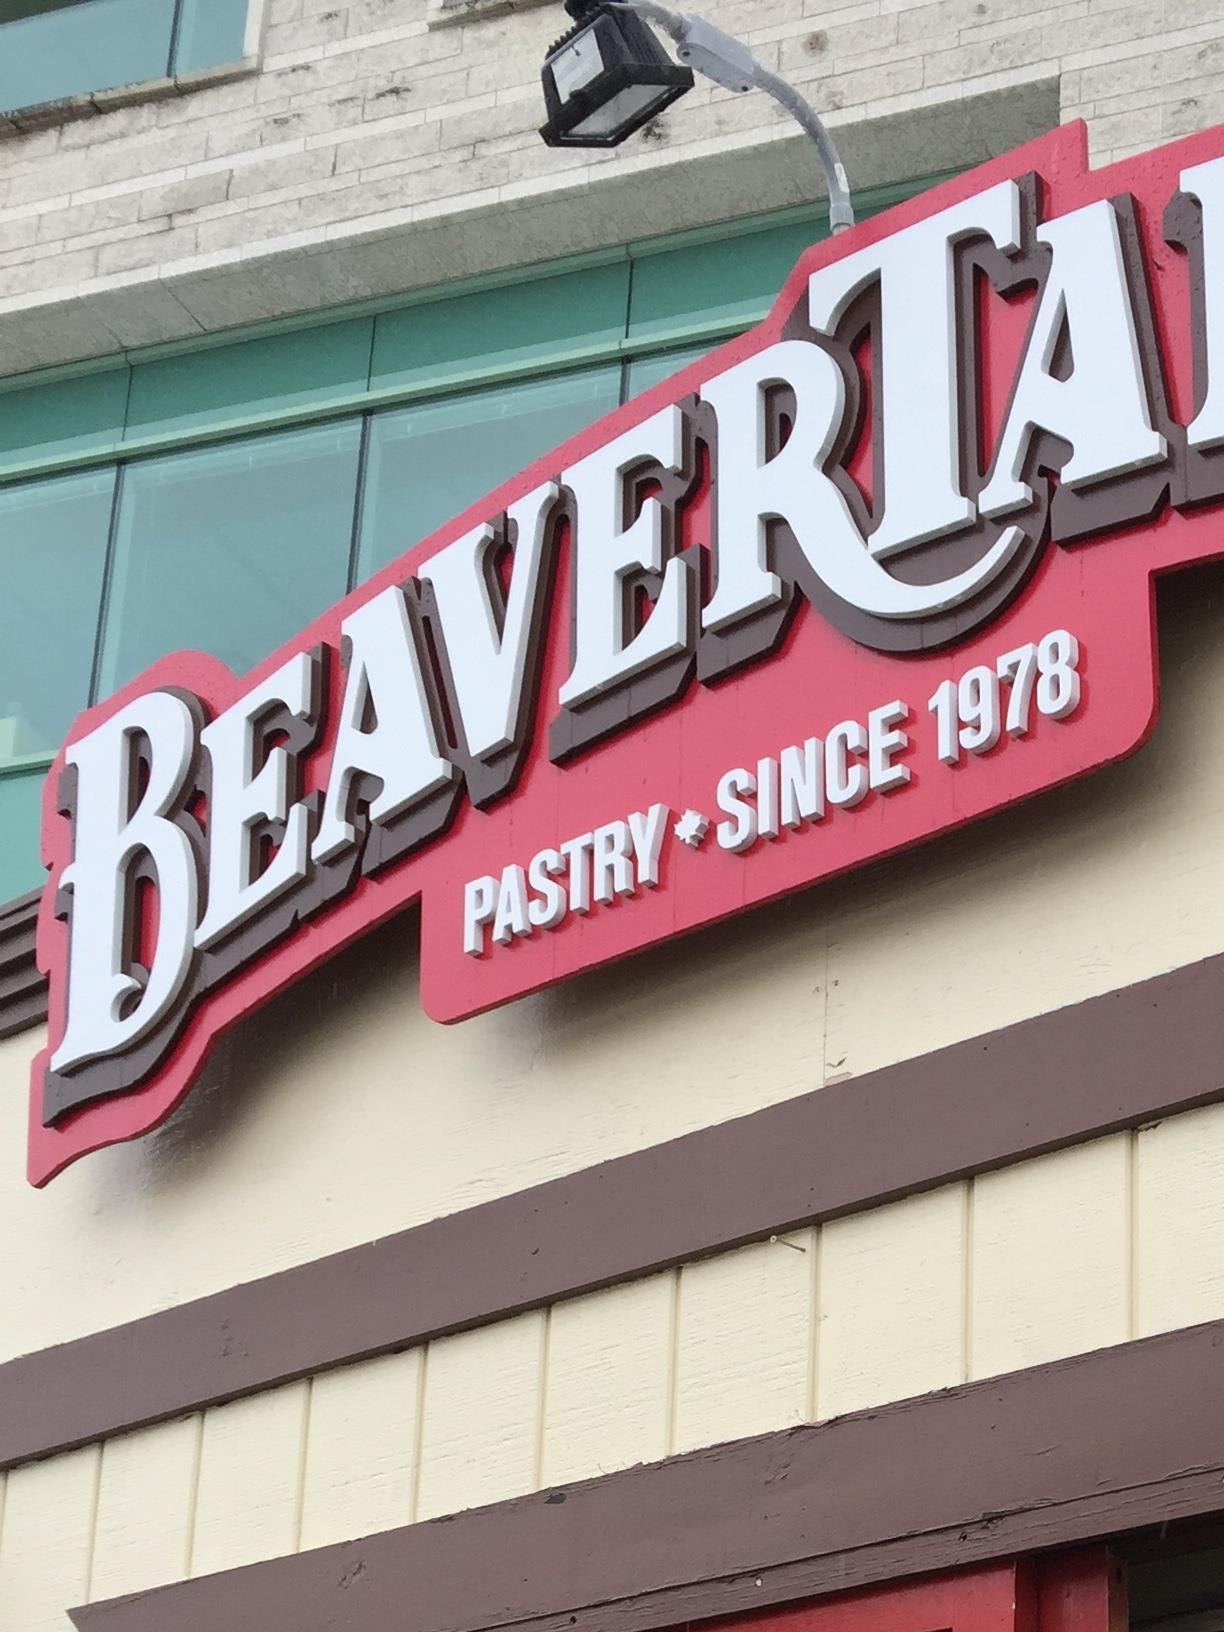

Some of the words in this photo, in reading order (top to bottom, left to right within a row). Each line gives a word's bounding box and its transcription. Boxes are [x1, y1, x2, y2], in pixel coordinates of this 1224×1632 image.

[463, 803, 670, 957] PASTRY
[715, 699, 911, 855] SINCE
[927, 629, 1080, 766] 1978
